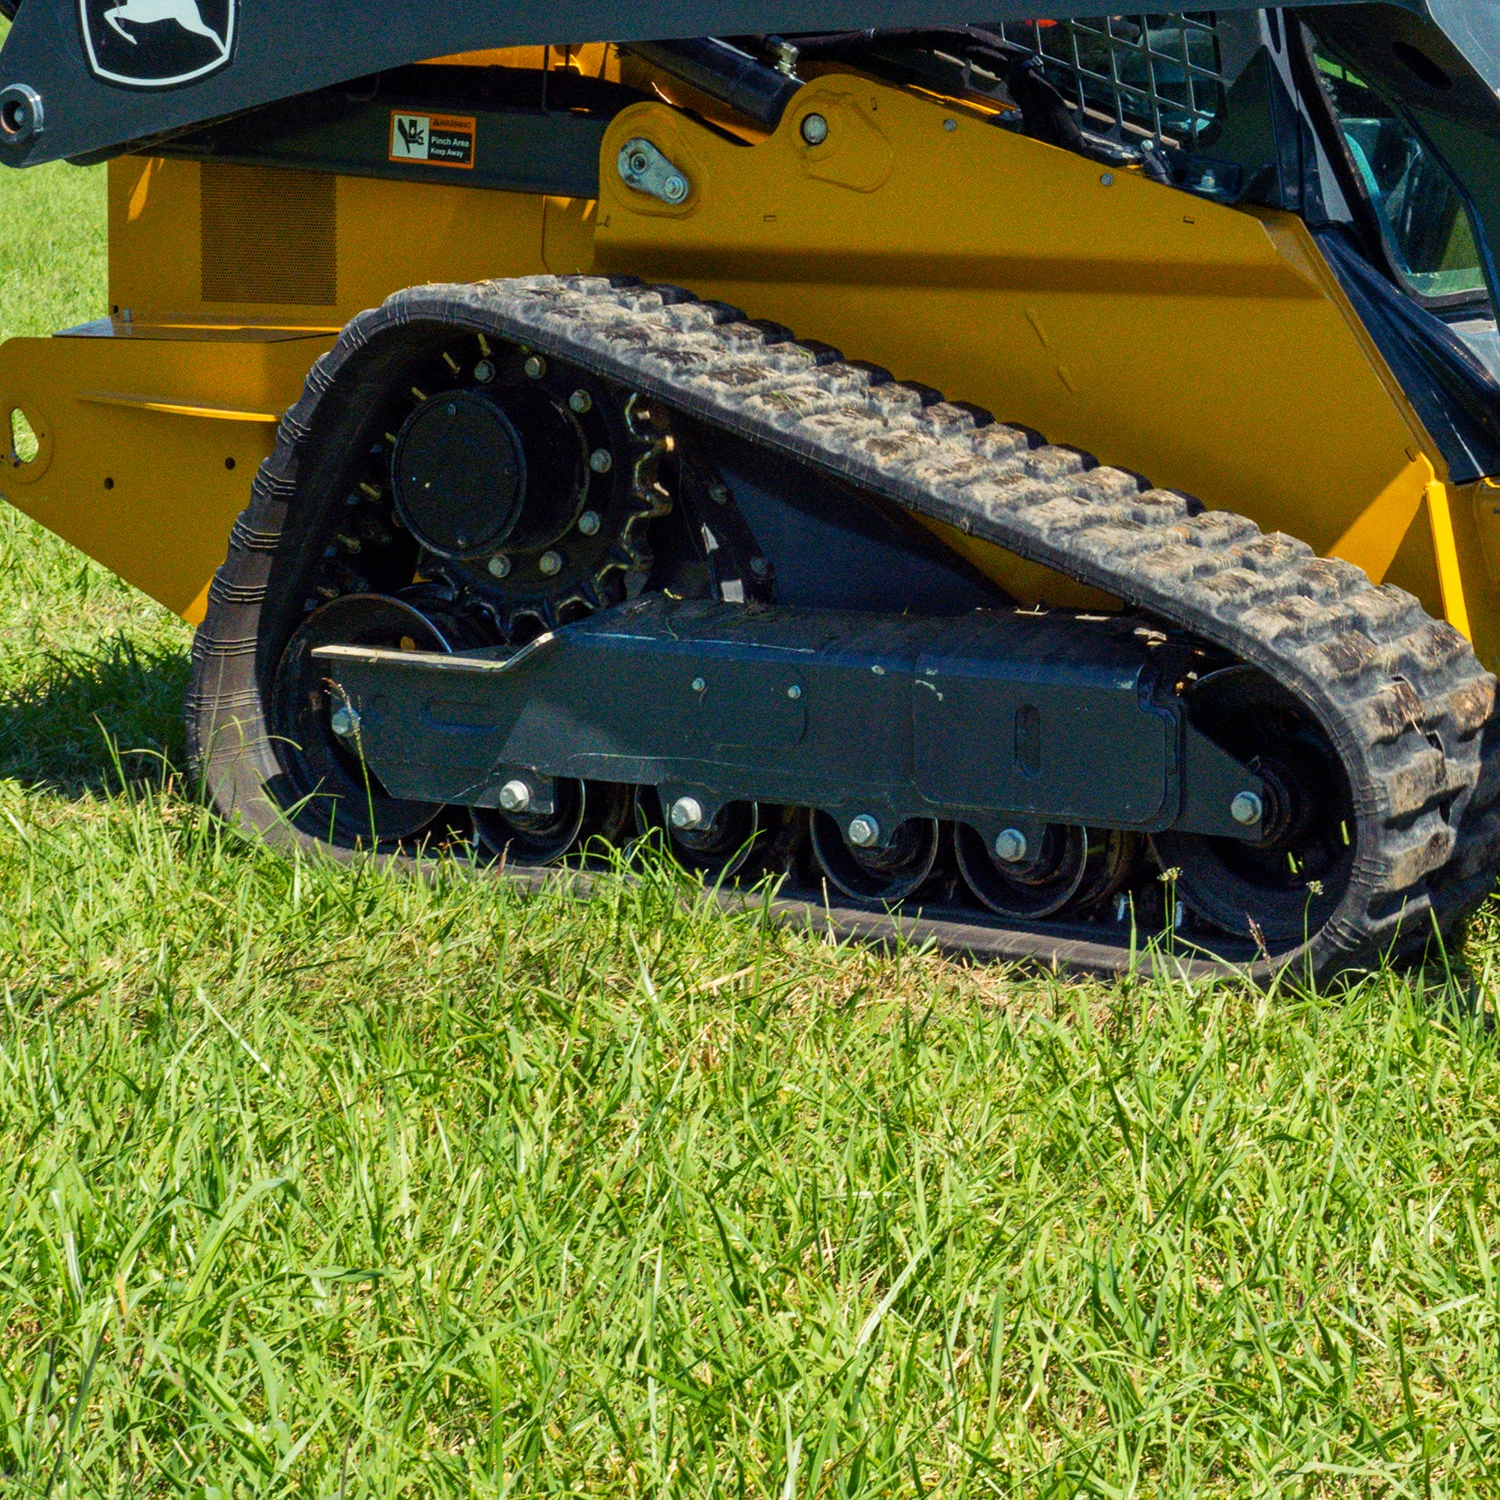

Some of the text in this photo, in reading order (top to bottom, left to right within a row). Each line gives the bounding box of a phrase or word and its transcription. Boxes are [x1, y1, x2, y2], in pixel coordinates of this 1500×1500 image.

[431, 136, 470, 148] Pinch Area
[430, 147, 464, 159] Keep Away
